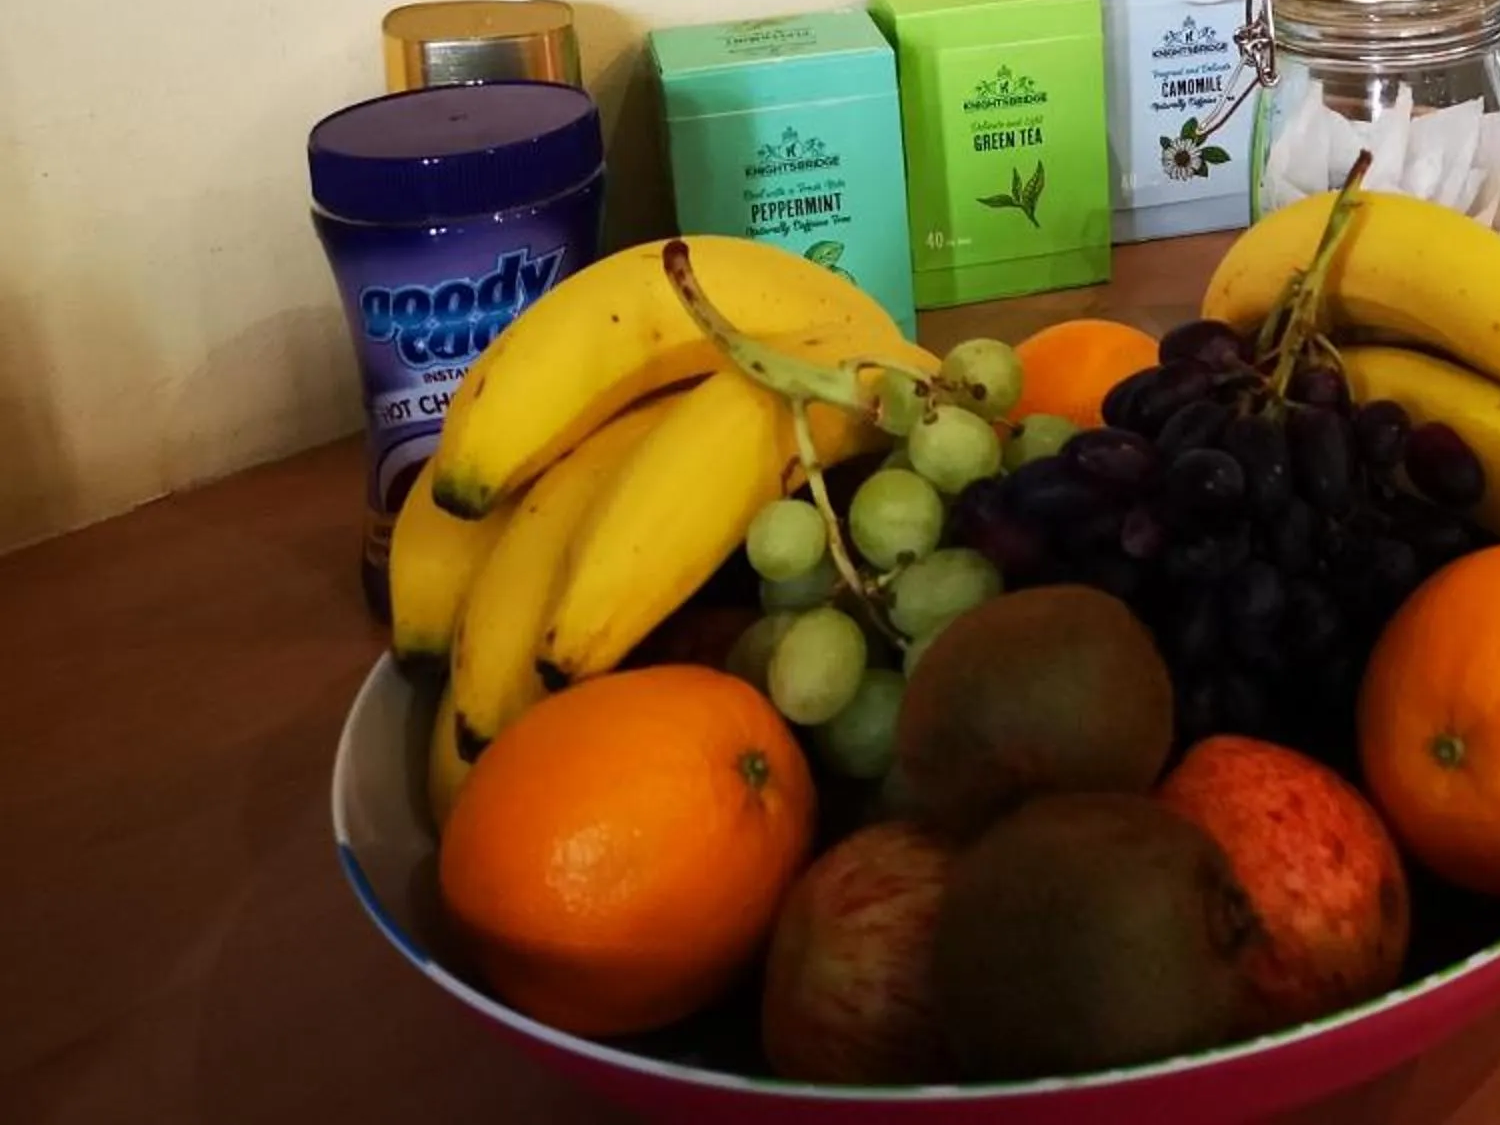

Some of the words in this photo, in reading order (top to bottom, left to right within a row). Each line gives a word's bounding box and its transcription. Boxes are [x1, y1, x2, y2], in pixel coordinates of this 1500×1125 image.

[1161, 75, 1223, 98] CAMOMILE
[973, 130, 1015, 152] GREEN
[1020, 127, 1043, 147] TEA
[744, 155, 840, 177] KNIGHTSBRIDGE
[751, 192, 842, 224] PEPPERMINT
[926, 230, 945, 250] 40
[361, 247, 566, 341] goody
[423, 366, 470, 384] INSTA
[381, 399, 412, 424] HOT
